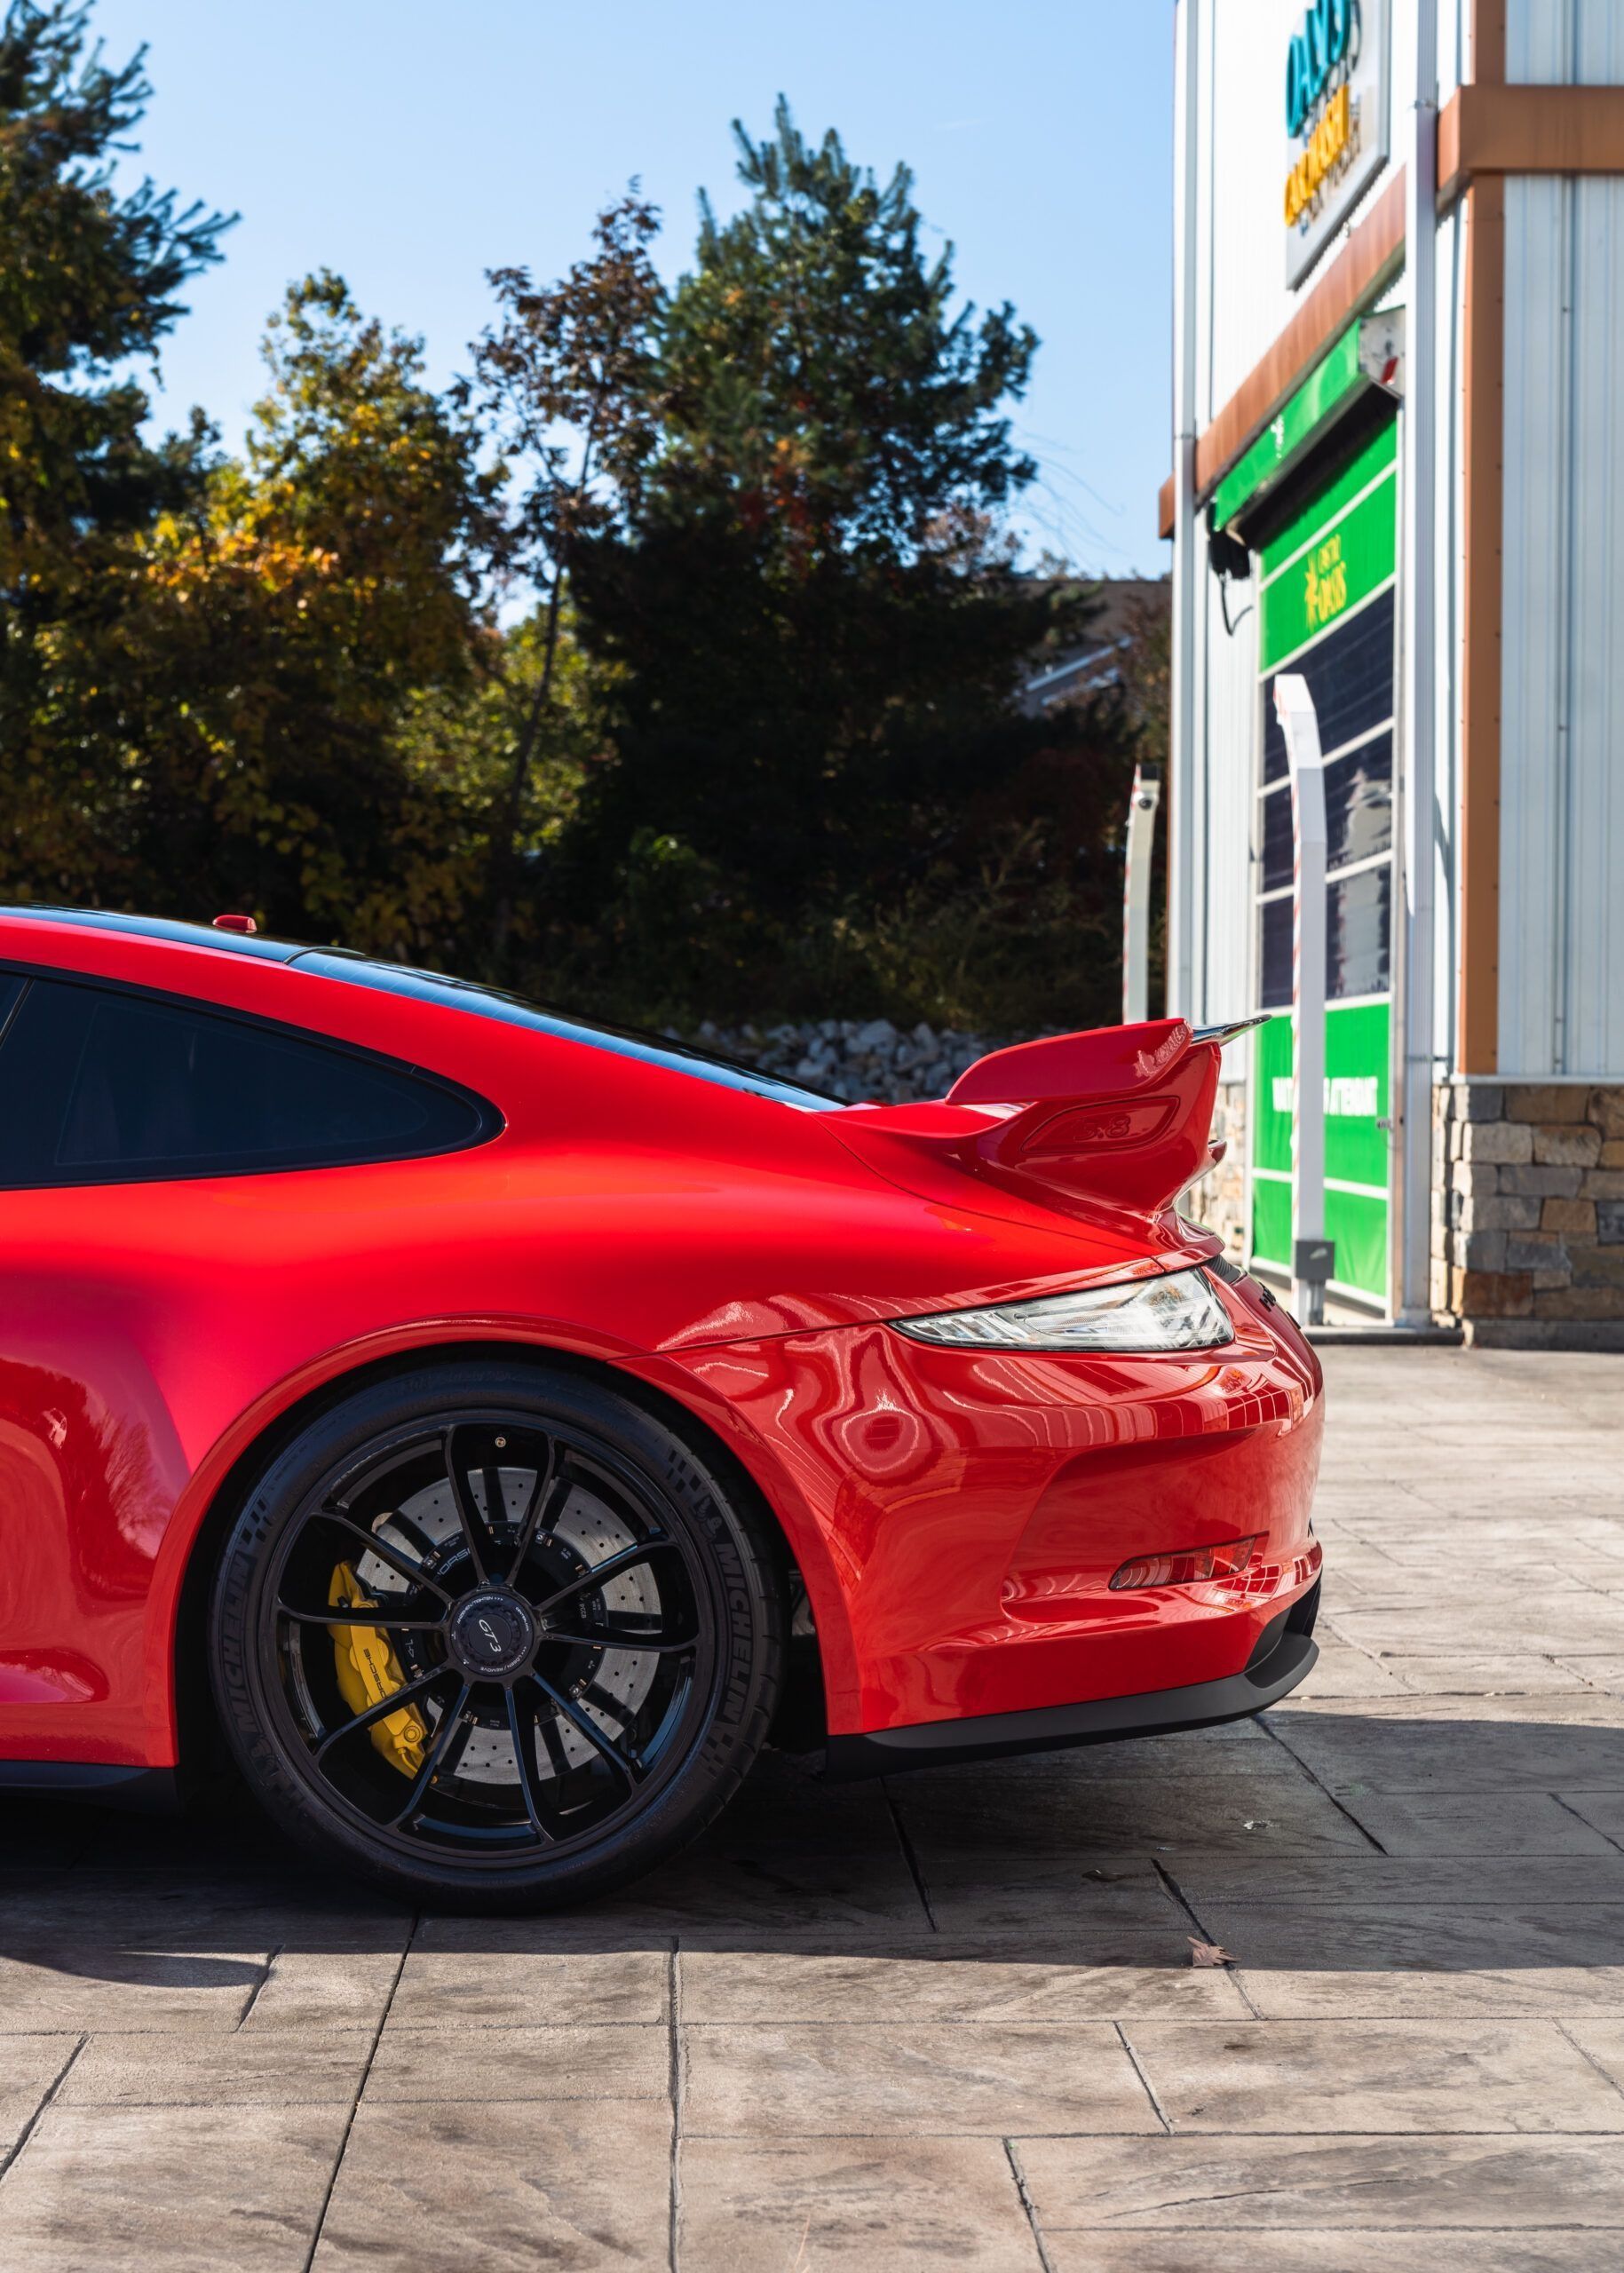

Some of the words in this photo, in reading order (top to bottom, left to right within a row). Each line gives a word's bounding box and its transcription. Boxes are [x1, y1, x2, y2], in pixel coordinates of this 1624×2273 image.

[223, 1550, 259, 1731] MICHELIN
[363, 1648, 387, 1699] ORSCHE
[714, 1543, 753, 1724] MICHELIN
